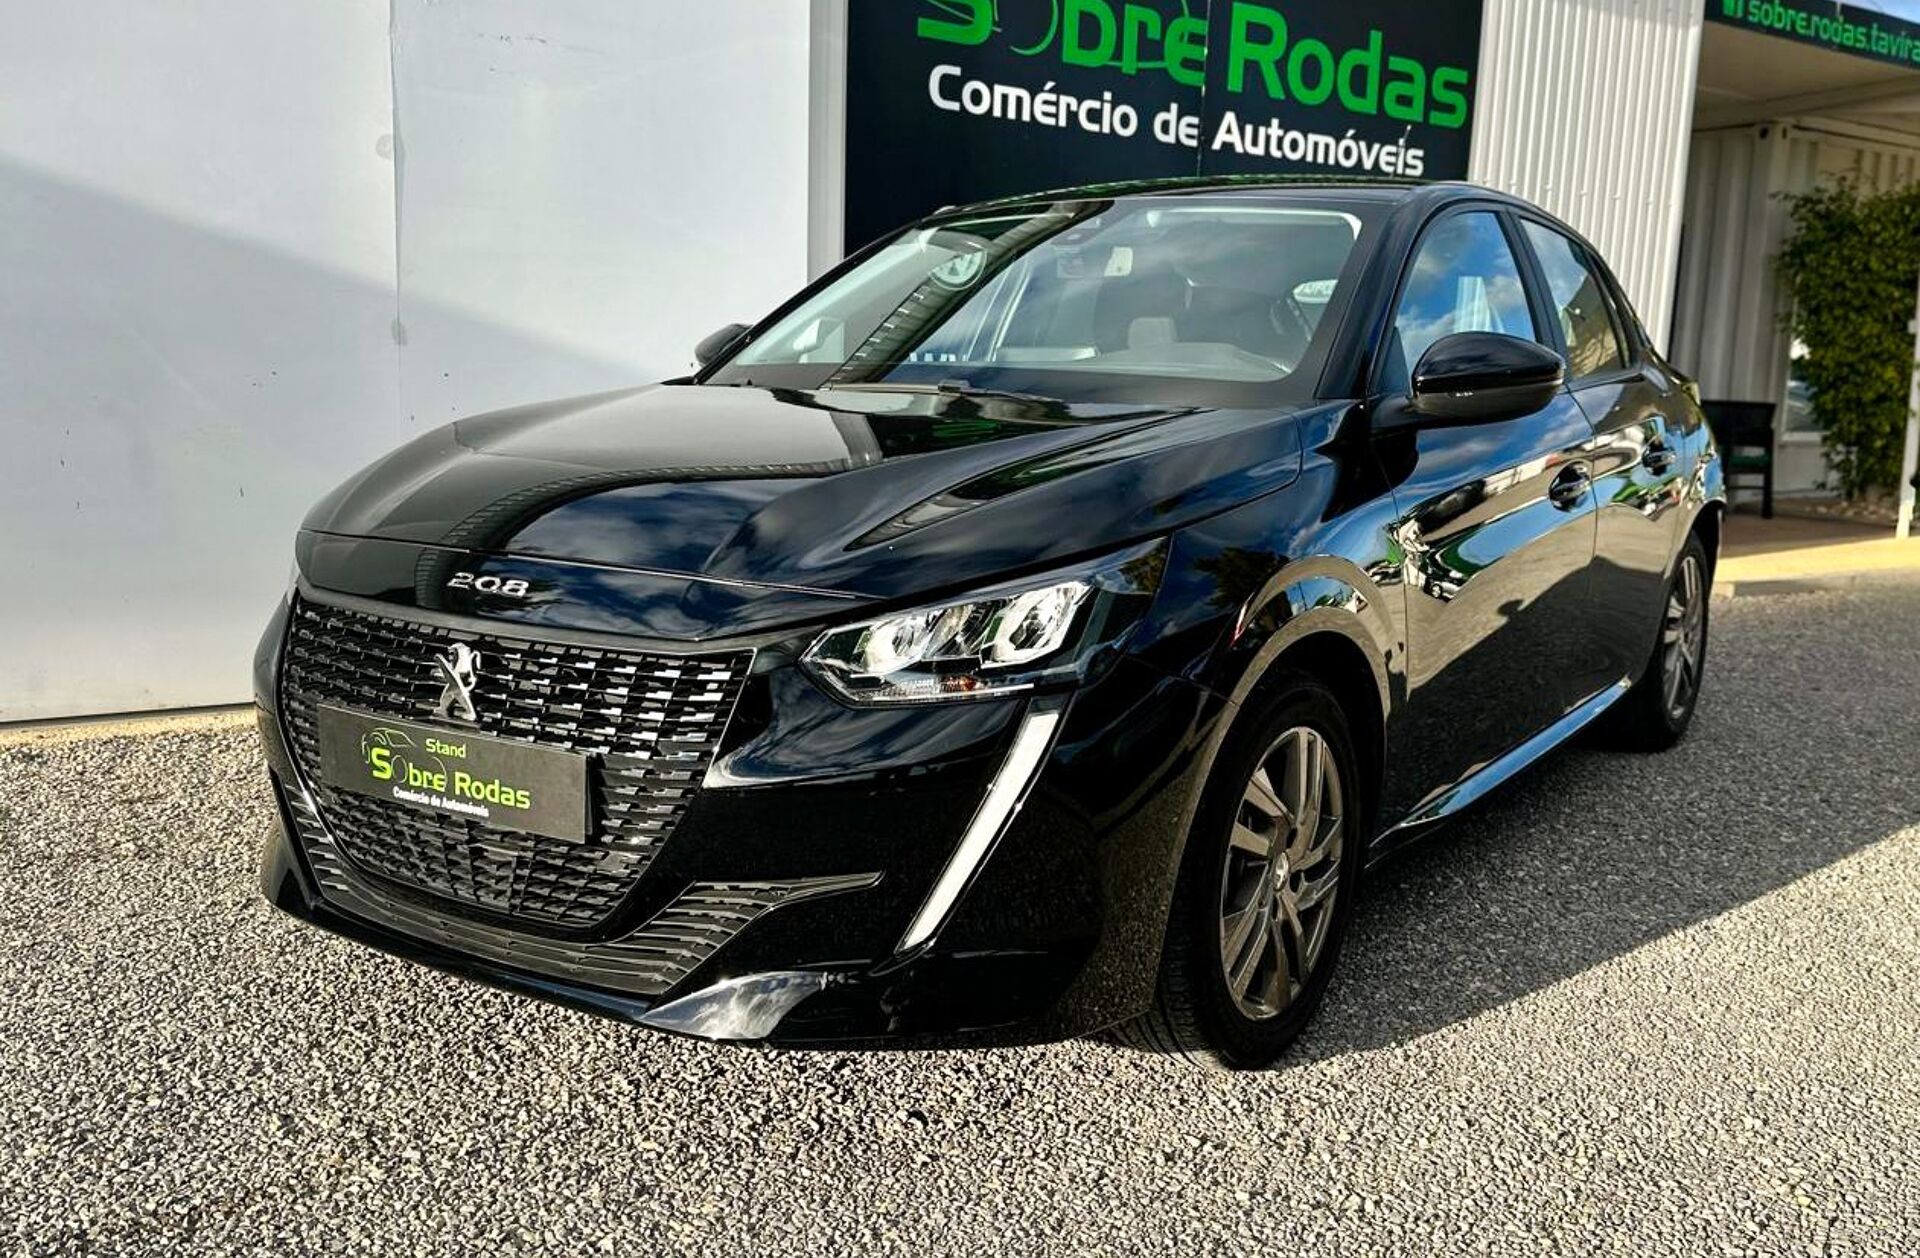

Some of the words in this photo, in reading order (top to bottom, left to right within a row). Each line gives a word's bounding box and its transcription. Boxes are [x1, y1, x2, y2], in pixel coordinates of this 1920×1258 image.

[1226, 1, 1469, 128] Rodas
[929, 64, 1138, 137] Comércio
[1153, 102, 1199, 146] de
[1211, 111, 1425, 177] Automóveis
[447, 572, 529, 597] 208
[371, 747, 446, 792] Sobre
[454, 771, 531, 809] Rodas
[425, 739, 466, 758] Stand
